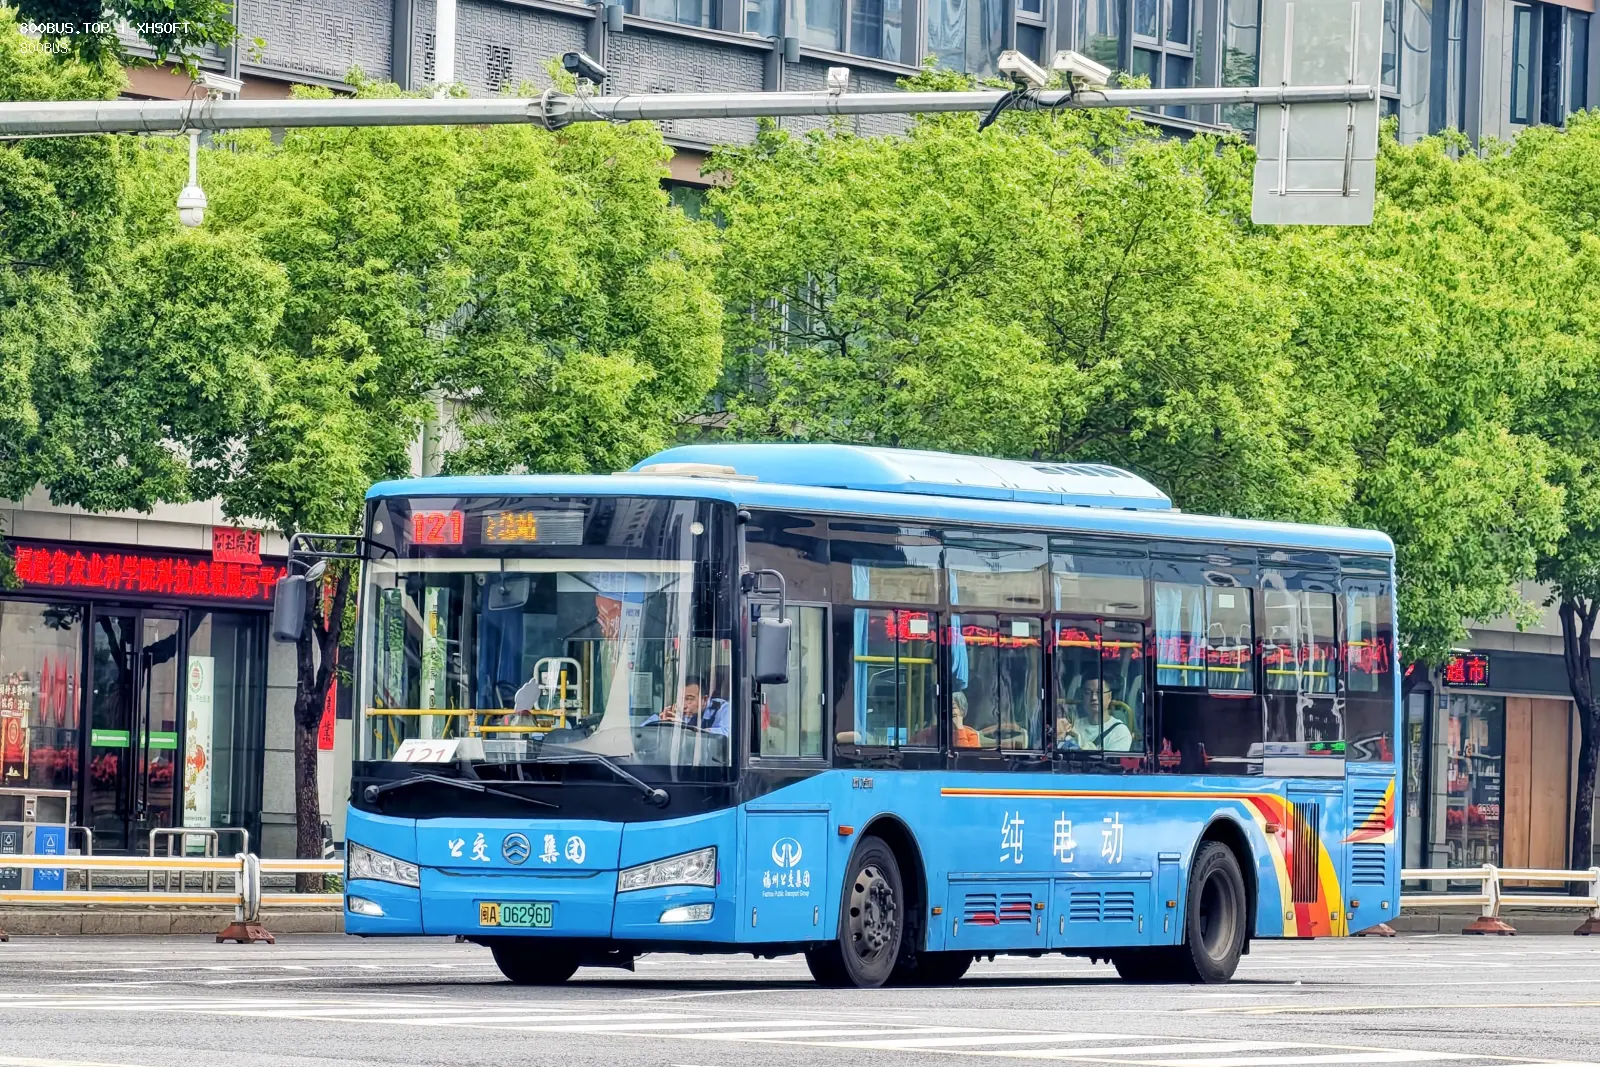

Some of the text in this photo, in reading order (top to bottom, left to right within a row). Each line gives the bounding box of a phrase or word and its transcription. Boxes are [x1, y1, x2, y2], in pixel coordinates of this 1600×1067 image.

[412, 511, 463, 544] 121
[1446, 656, 1487, 683] 超市
[404, 748, 447, 762] 121
[999, 810, 1124, 865] 纯电动
[762, 869, 811, 889] 福州公交集团
